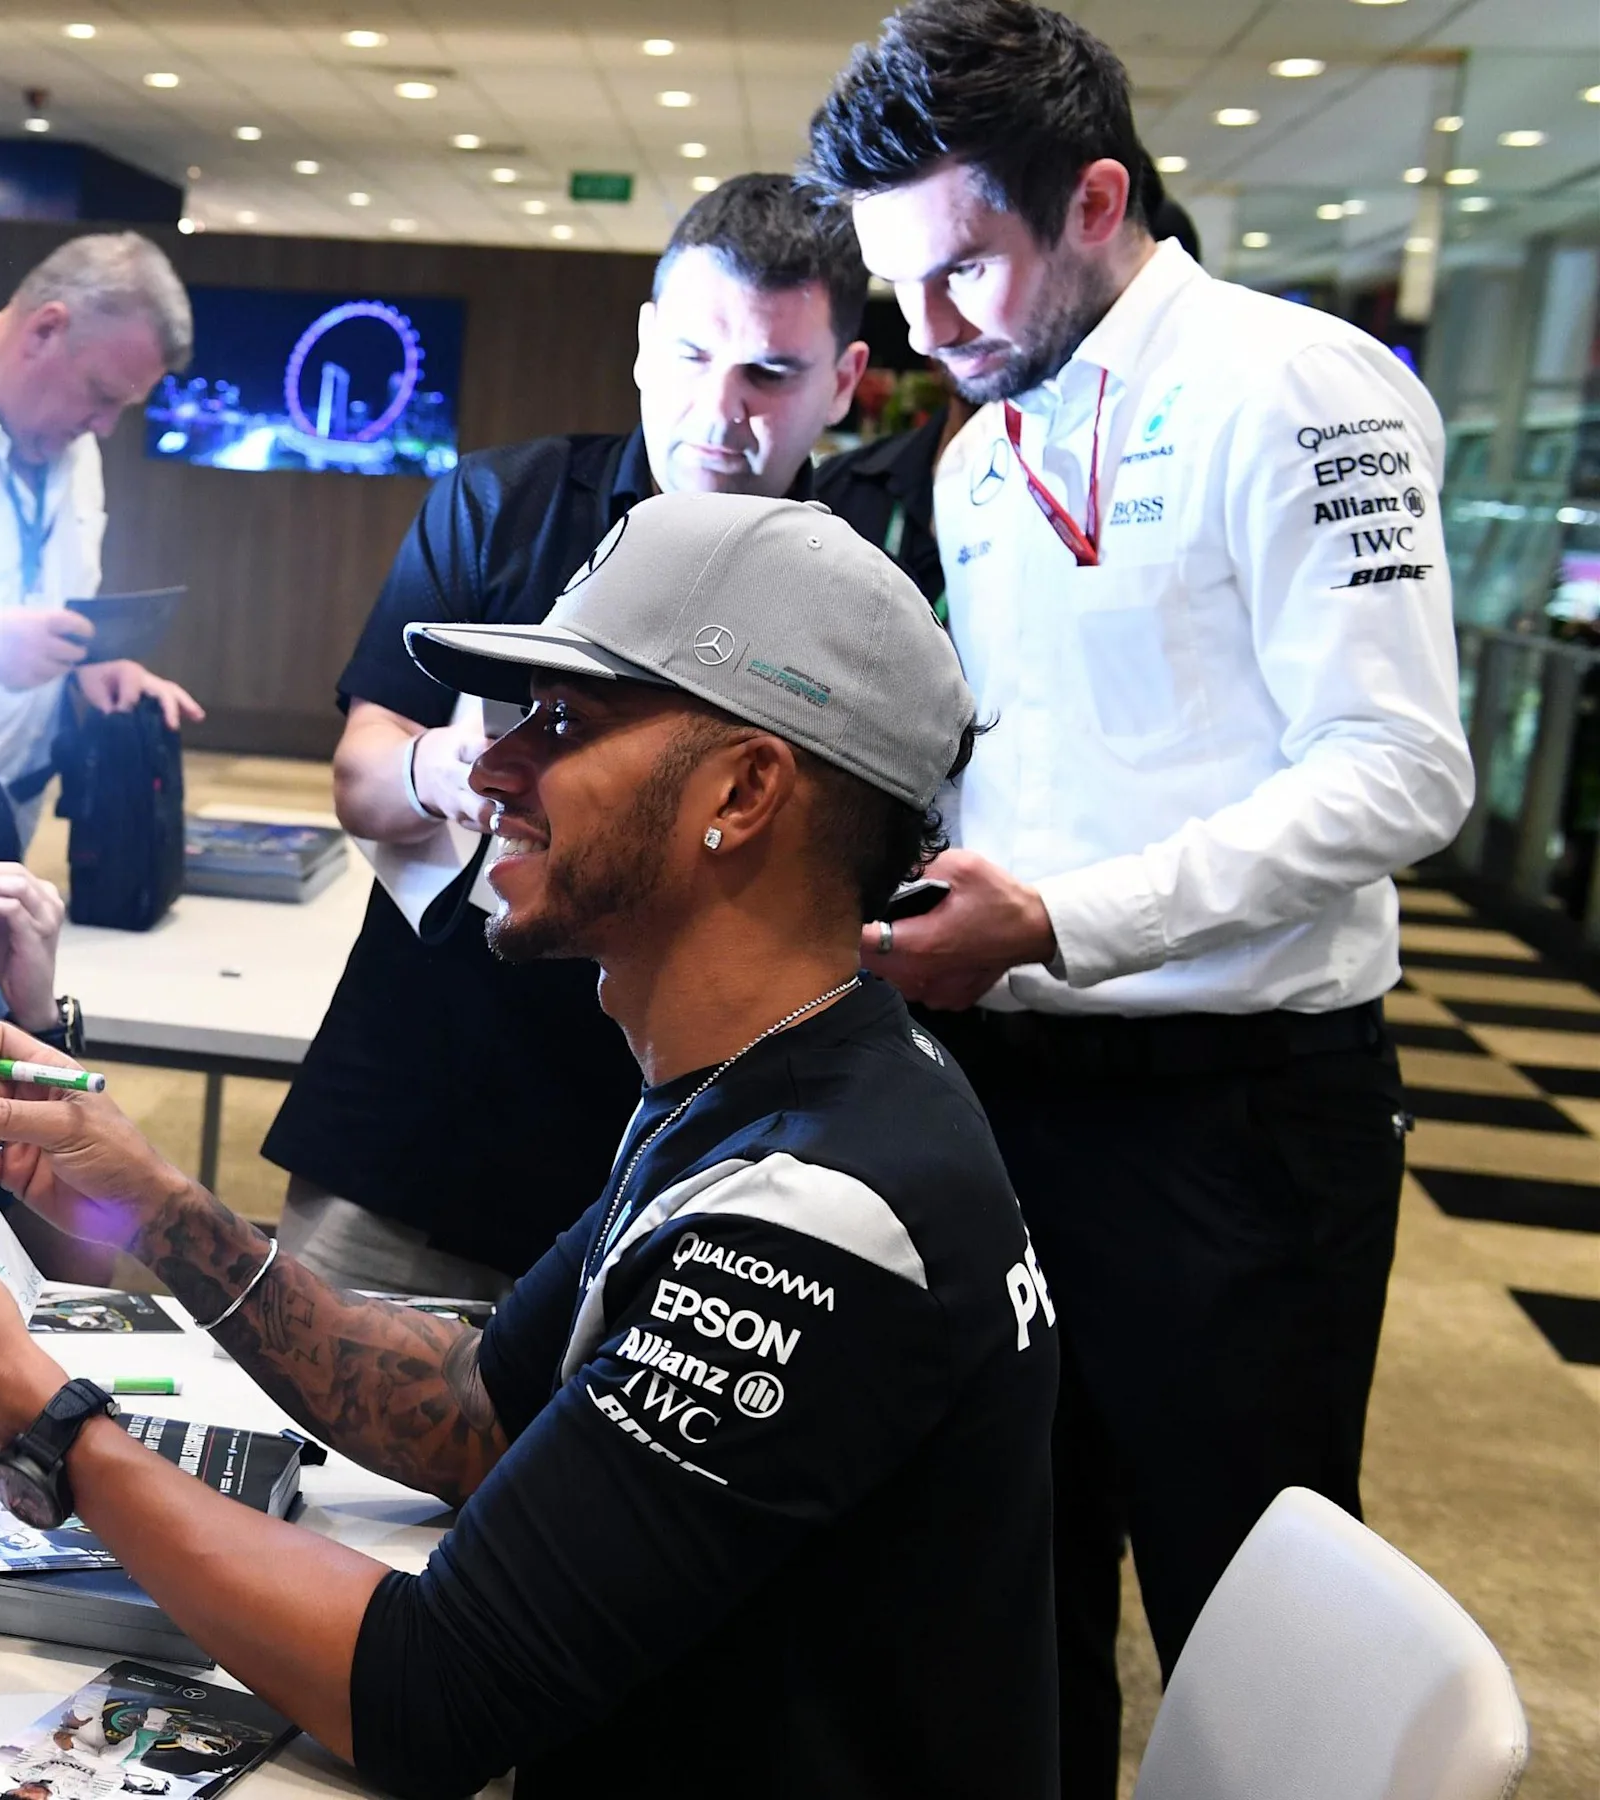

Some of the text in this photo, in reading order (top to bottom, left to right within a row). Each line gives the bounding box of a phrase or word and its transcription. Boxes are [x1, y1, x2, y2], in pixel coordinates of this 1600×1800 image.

[1297, 419, 1407, 453] QUALCOMM
[1314, 452, 1411, 487] EPSON
[1113, 496, 1164, 518] BOSS
[1314, 497, 1401, 526] Allianz
[1350, 526, 1415, 558] IWC
[1330, 564, 1434, 590] BOSE
[672, 1232, 834, 1312] QUALCOMM
[650, 1279, 801, 1365] EPSON
[616, 1326, 729, 1395] Allianz
[619, 1368, 722, 1444] IWC
